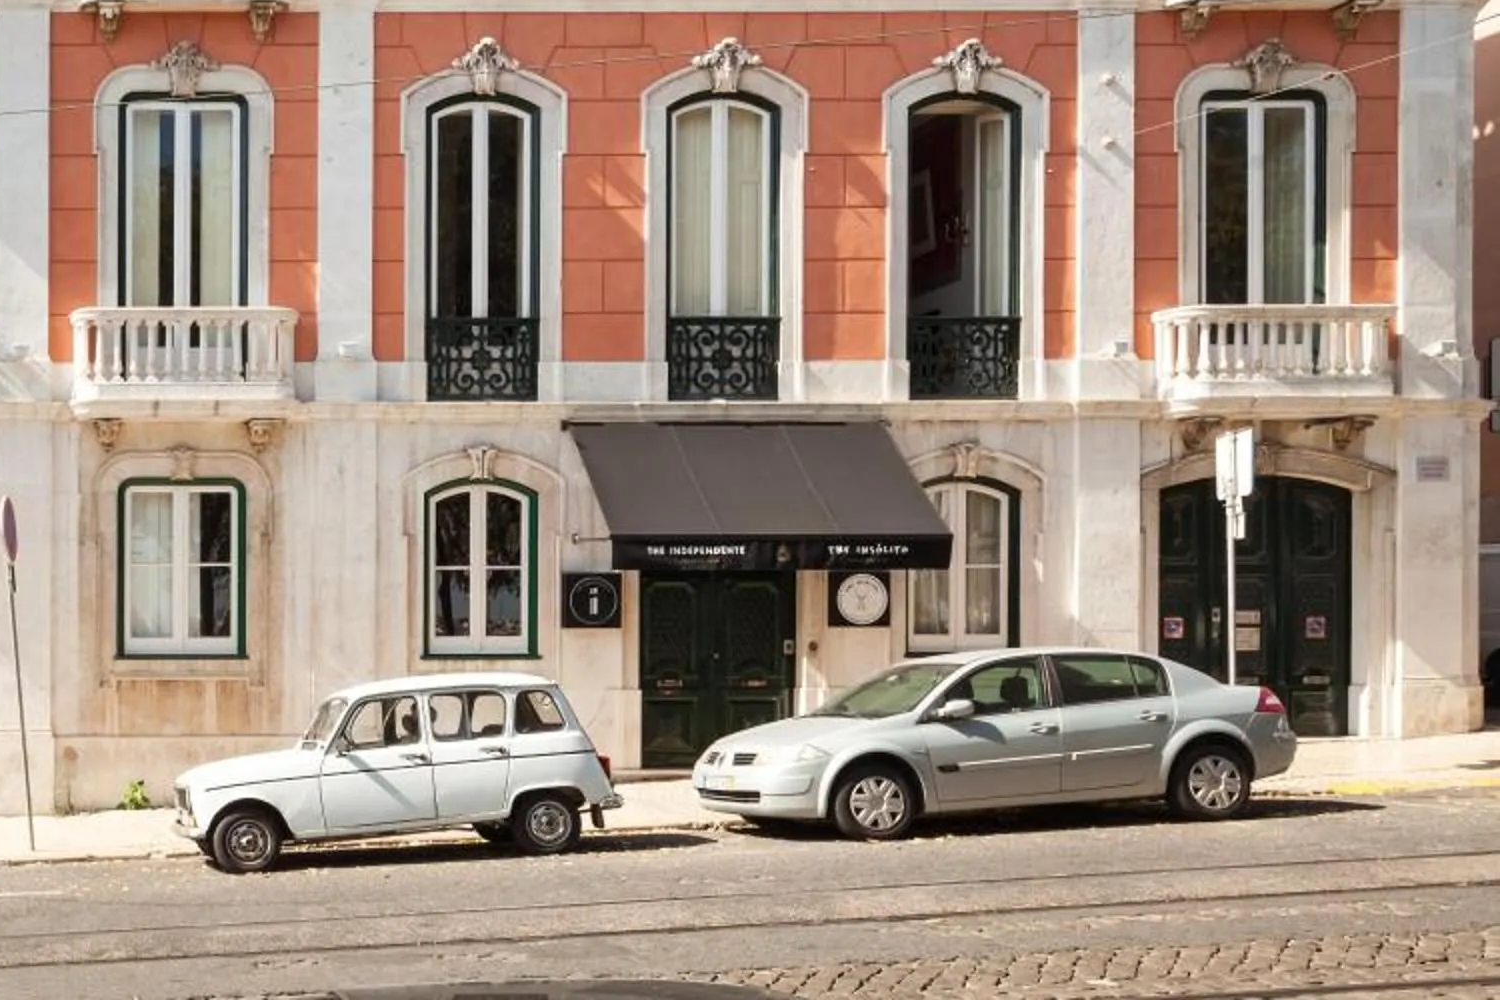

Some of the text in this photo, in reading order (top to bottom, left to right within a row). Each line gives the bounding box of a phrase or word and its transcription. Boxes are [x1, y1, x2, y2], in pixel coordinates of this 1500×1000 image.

[647, 545, 745, 555] THE INDEPENDENTE
[827, 545, 850, 555] THE
